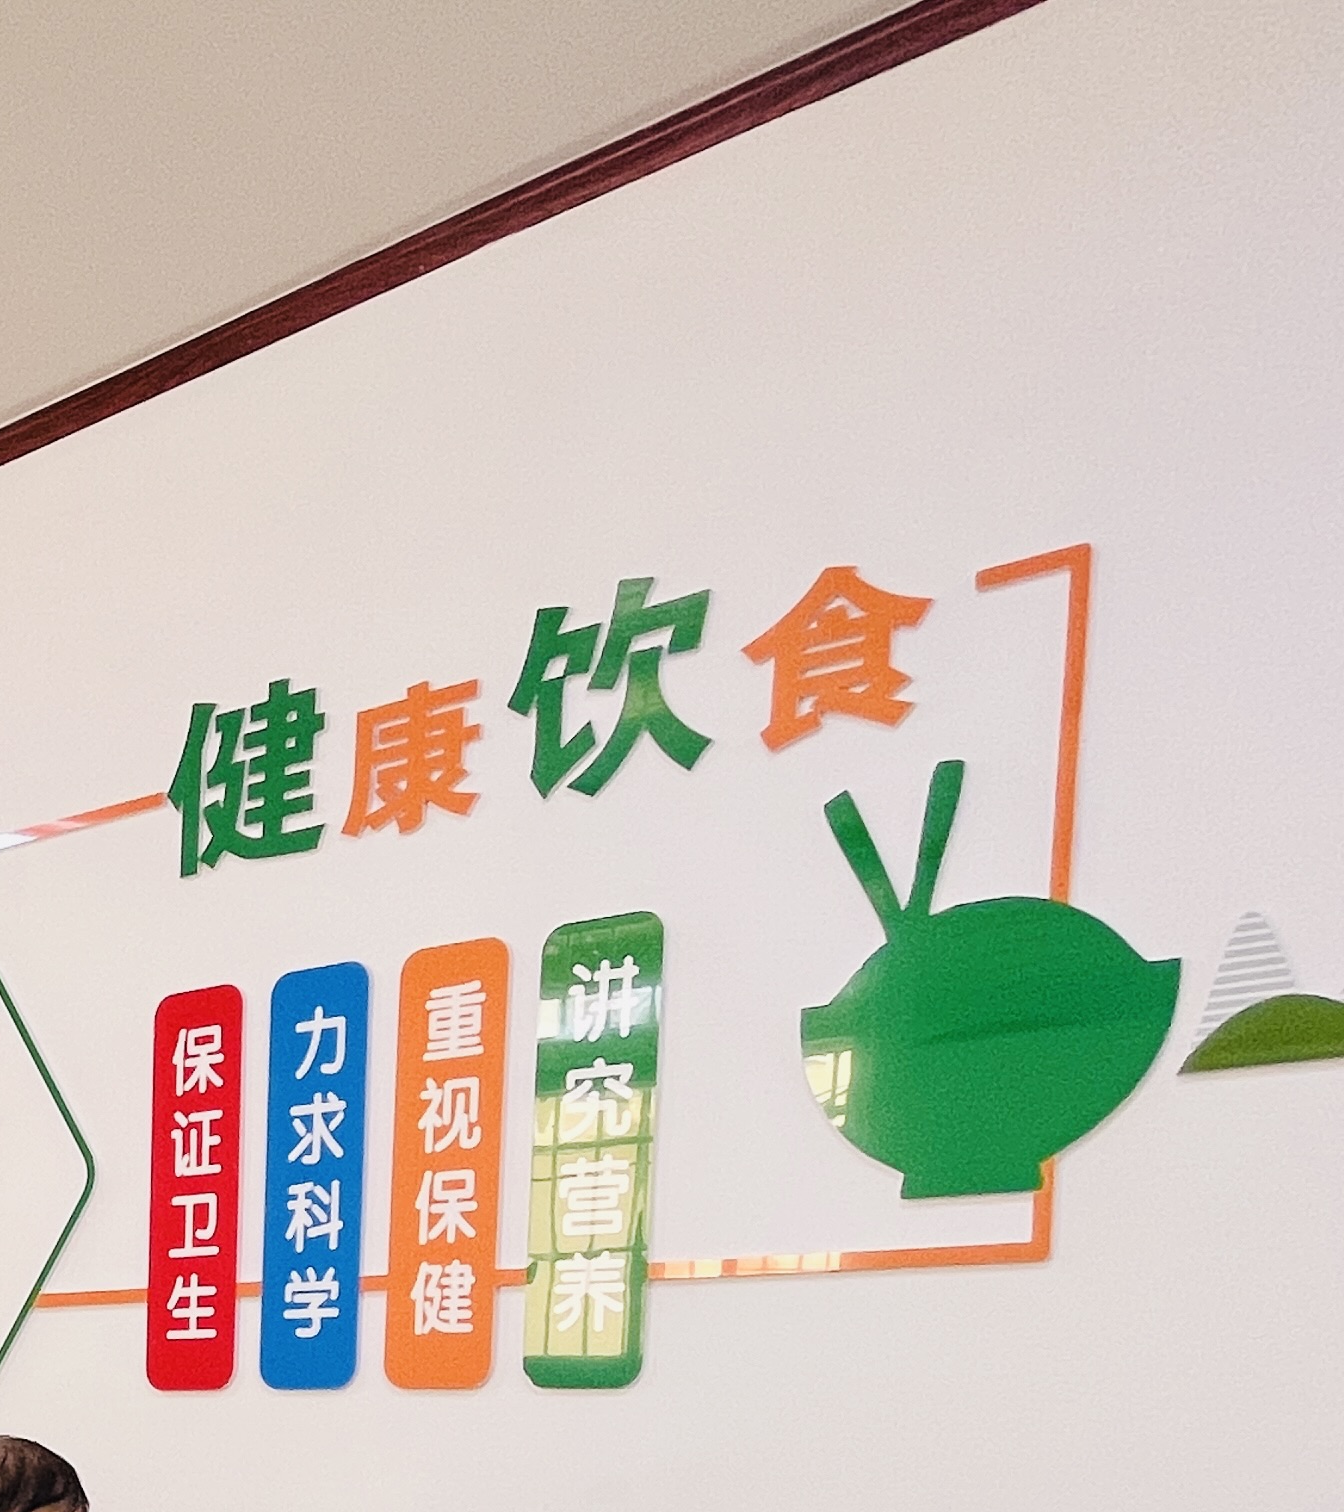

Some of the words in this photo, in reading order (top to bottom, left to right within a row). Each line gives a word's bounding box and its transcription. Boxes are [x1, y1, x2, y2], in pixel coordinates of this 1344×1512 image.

[167, 566, 932, 877] 健康饮食
[166, 1024, 225, 1340] 保证卫生
[283, 1006, 347, 1338] 力求科学
[411, 980, 486, 1336] 重视保健
[553, 955, 641, 1333] 讲究营养
